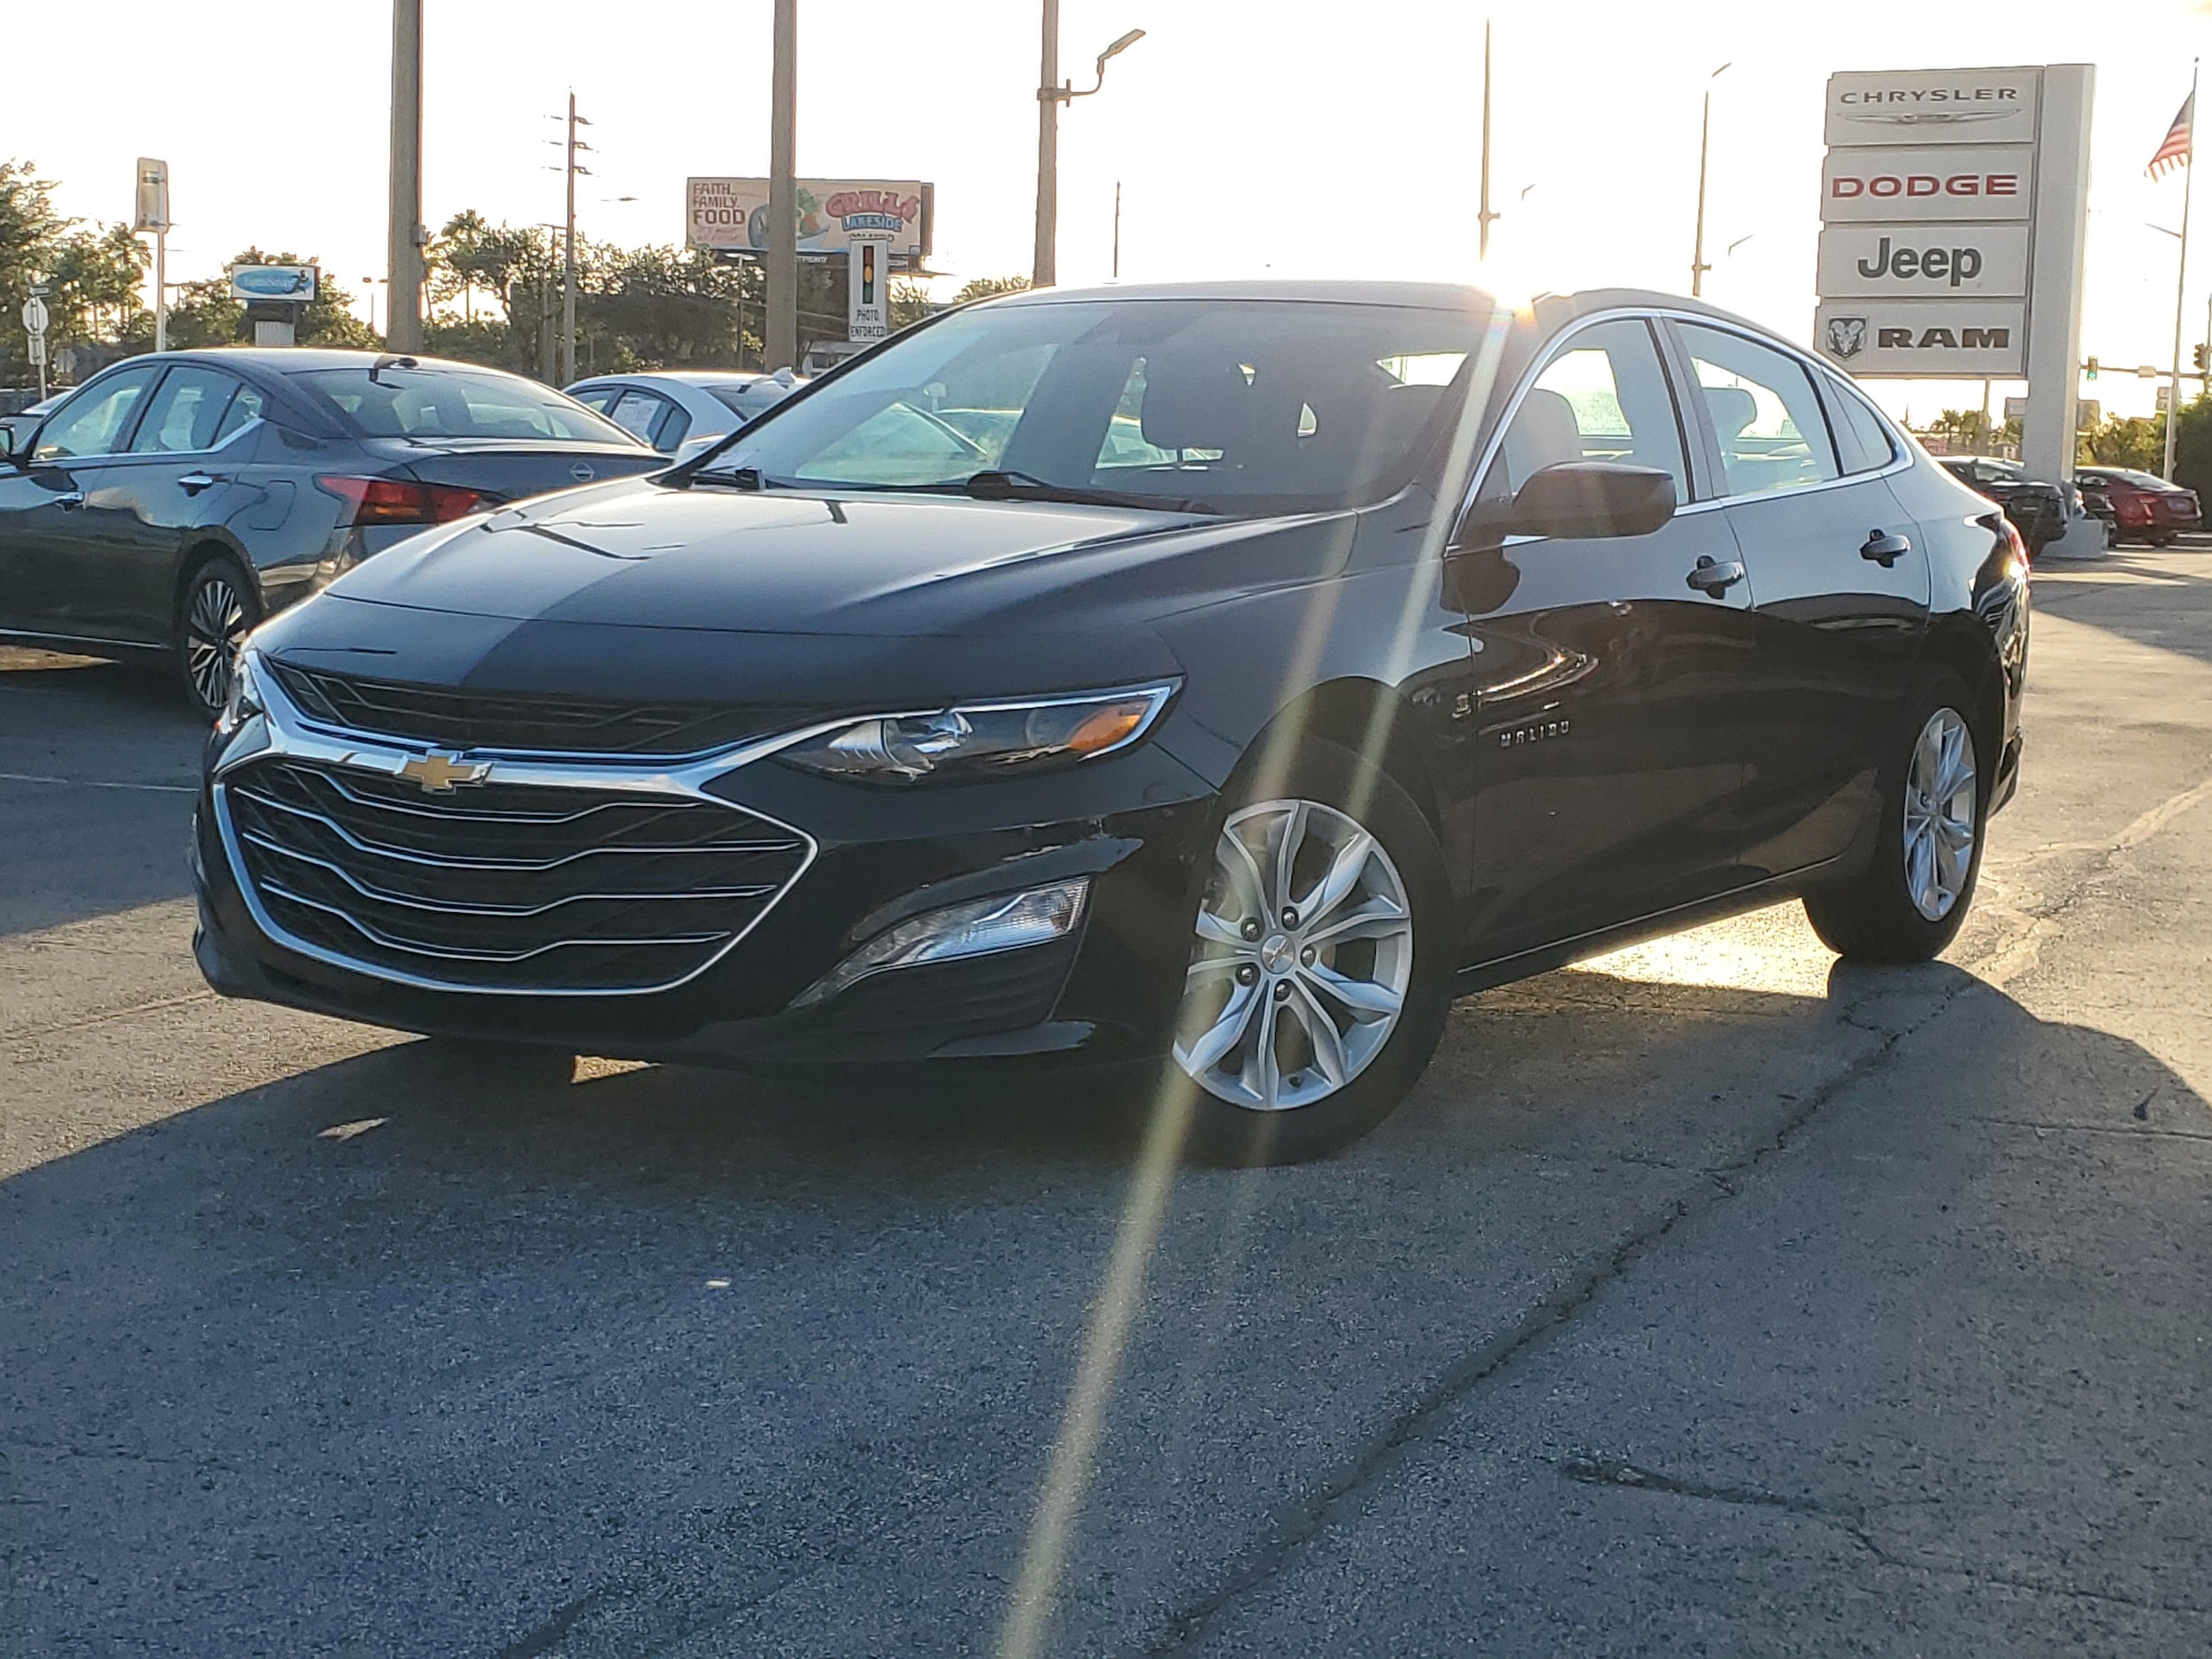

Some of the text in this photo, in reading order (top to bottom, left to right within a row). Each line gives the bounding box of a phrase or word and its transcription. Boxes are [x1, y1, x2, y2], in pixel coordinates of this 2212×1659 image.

[1839, 88, 2017, 104] CHRYSLER
[1832, 174, 2018, 198] DODGE
[693, 196, 740, 208] FAMILY.
[826, 190, 920, 224] GRILLS
[693, 209, 746, 225] FOOD
[841, 214, 903, 233] LAKESIDE
[1857, 236, 1982, 287] Jeep
[856, 309, 879, 321] PHOTO
[850, 326, 885, 337] ENFORCED
[1878, 328, 2009, 349] RAM
[1501, 720, 1570, 748] MALIBU
